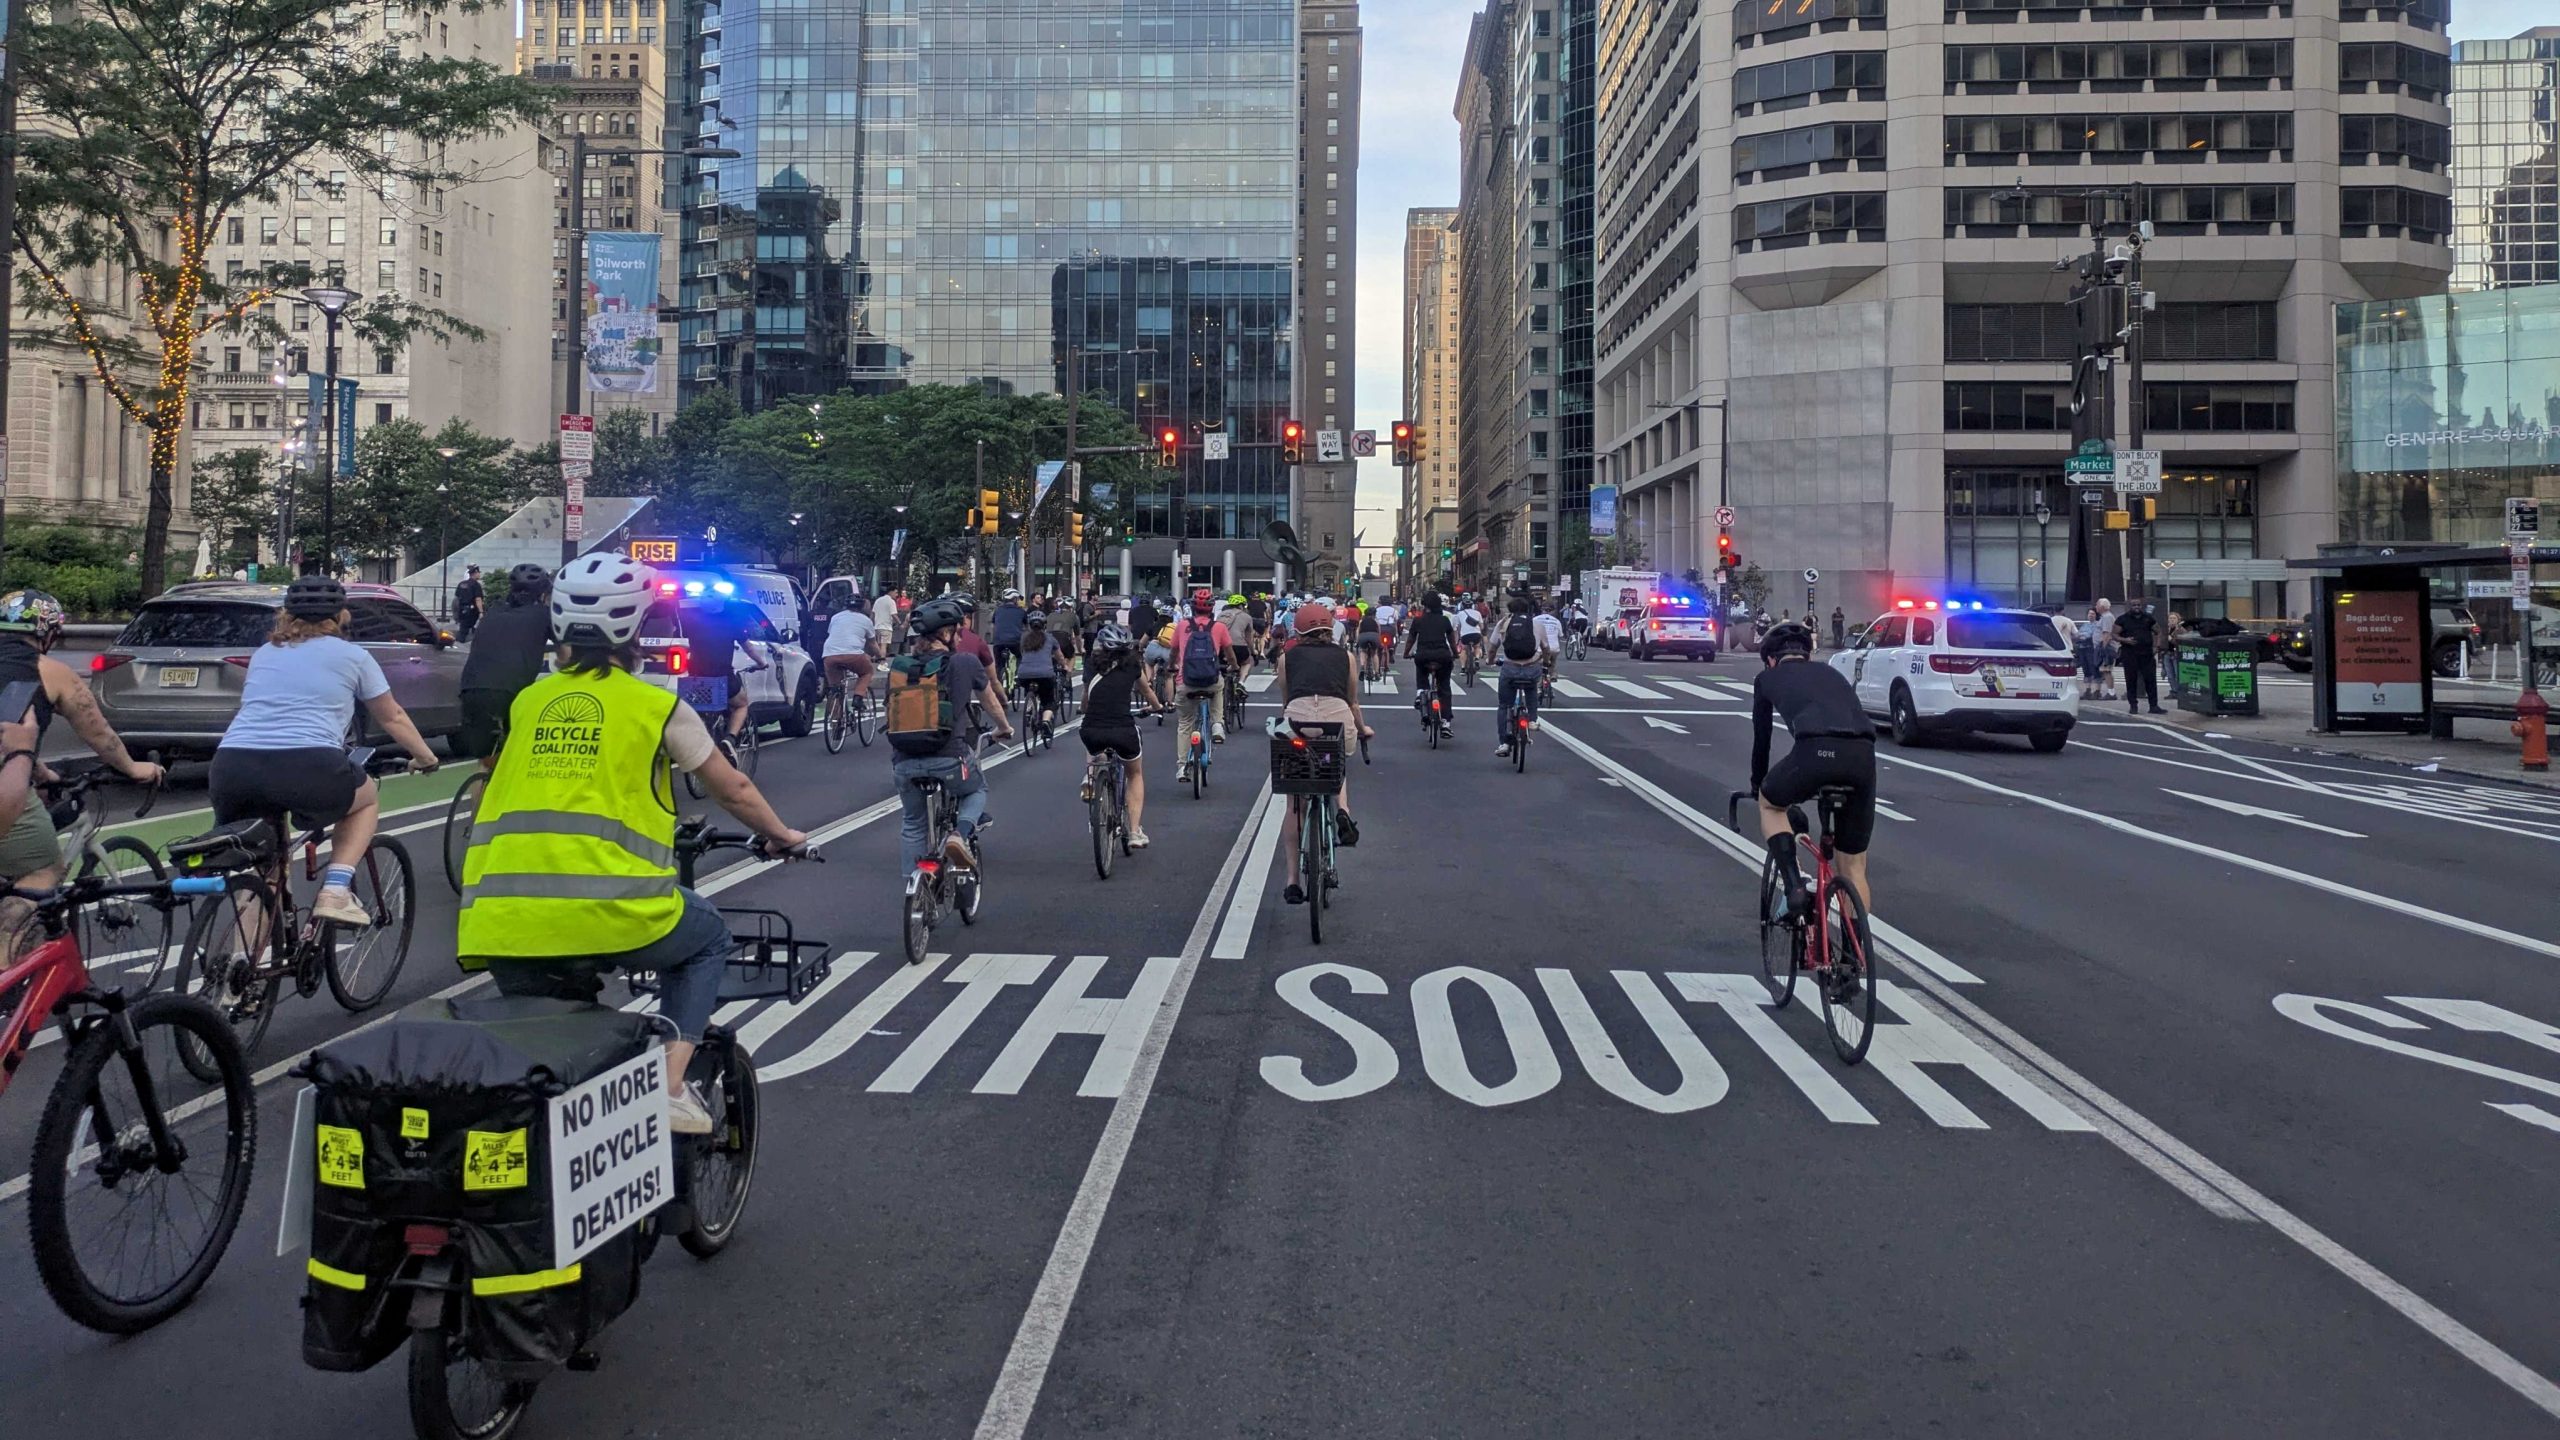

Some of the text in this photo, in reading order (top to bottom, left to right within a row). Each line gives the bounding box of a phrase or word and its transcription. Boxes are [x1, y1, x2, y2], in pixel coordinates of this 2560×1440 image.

[595, 257, 646, 269] Dilworth
[595, 270, 622, 280] Park
[341, 386, 351, 460] Dilworth Park
[1322, 432, 1336, 440] ONE
[2385, 429, 2470, 447] CENTRE
[2070, 460, 2110, 470] Market
[2117, 482, 2158, 490] THE BOX
[2511, 515, 2520, 523] 16
[2511, 523, 2520, 531] 27
[635, 544, 673, 559] RISE
[757, 591, 786, 605] POLICE
[2392, 615, 2404, 623] go
[1910, 663, 1924, 675] 911
[534, 727, 602, 741] BICYCLE
[532, 743, 599, 755] COALITION
[529, 756, 597, 769] OF GREATER
[527, 769, 593, 780] PHILADELPHIA
[1259, 962, 2098, 1130] SOUTH
[562, 1059, 660, 1138] NO MORE
[331, 1136, 349, 1146] MUST
[569, 1113, 659, 1192] BICYCLE
[337, 1155, 345, 1169] 4
[488, 1159, 499, 1172] 4
[332, 1171, 352, 1181] FEET
[483, 1174, 509, 1184] FEET
[572, 1166, 662, 1250] DEATHS!
